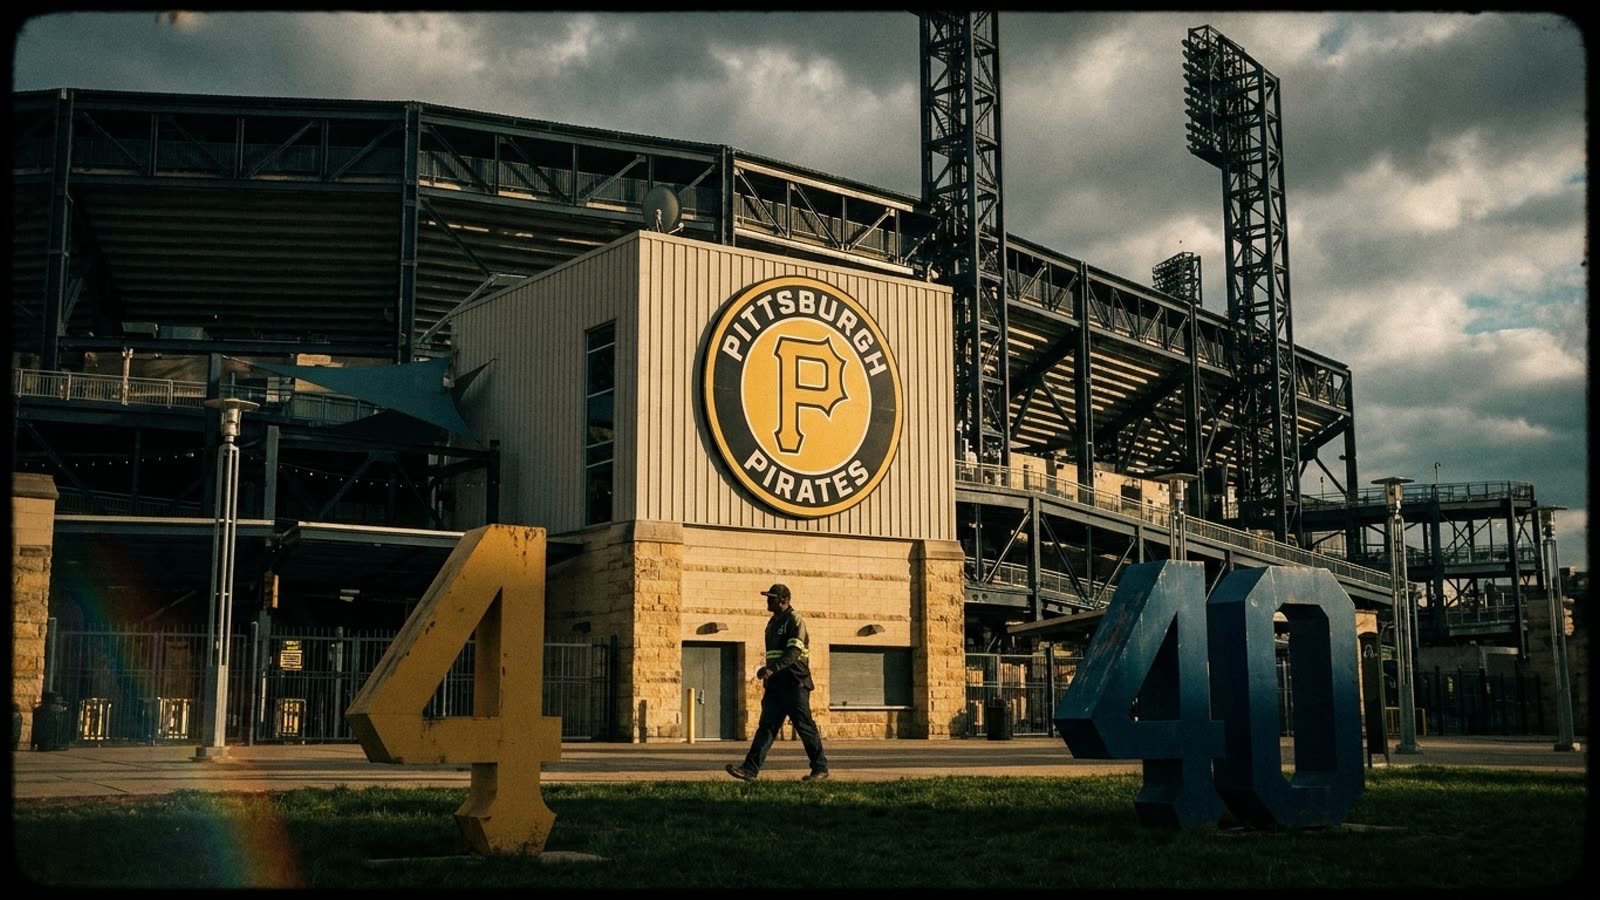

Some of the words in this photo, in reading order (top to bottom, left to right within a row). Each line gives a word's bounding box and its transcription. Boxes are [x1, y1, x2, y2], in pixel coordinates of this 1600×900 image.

[722, 290, 888, 377] PITTSBURGH
[773, 334, 852, 456] P
[743, 449, 869, 504] PIRATES
[346, 523, 563, 856] 4
[1053, 559, 1366, 828] 40
